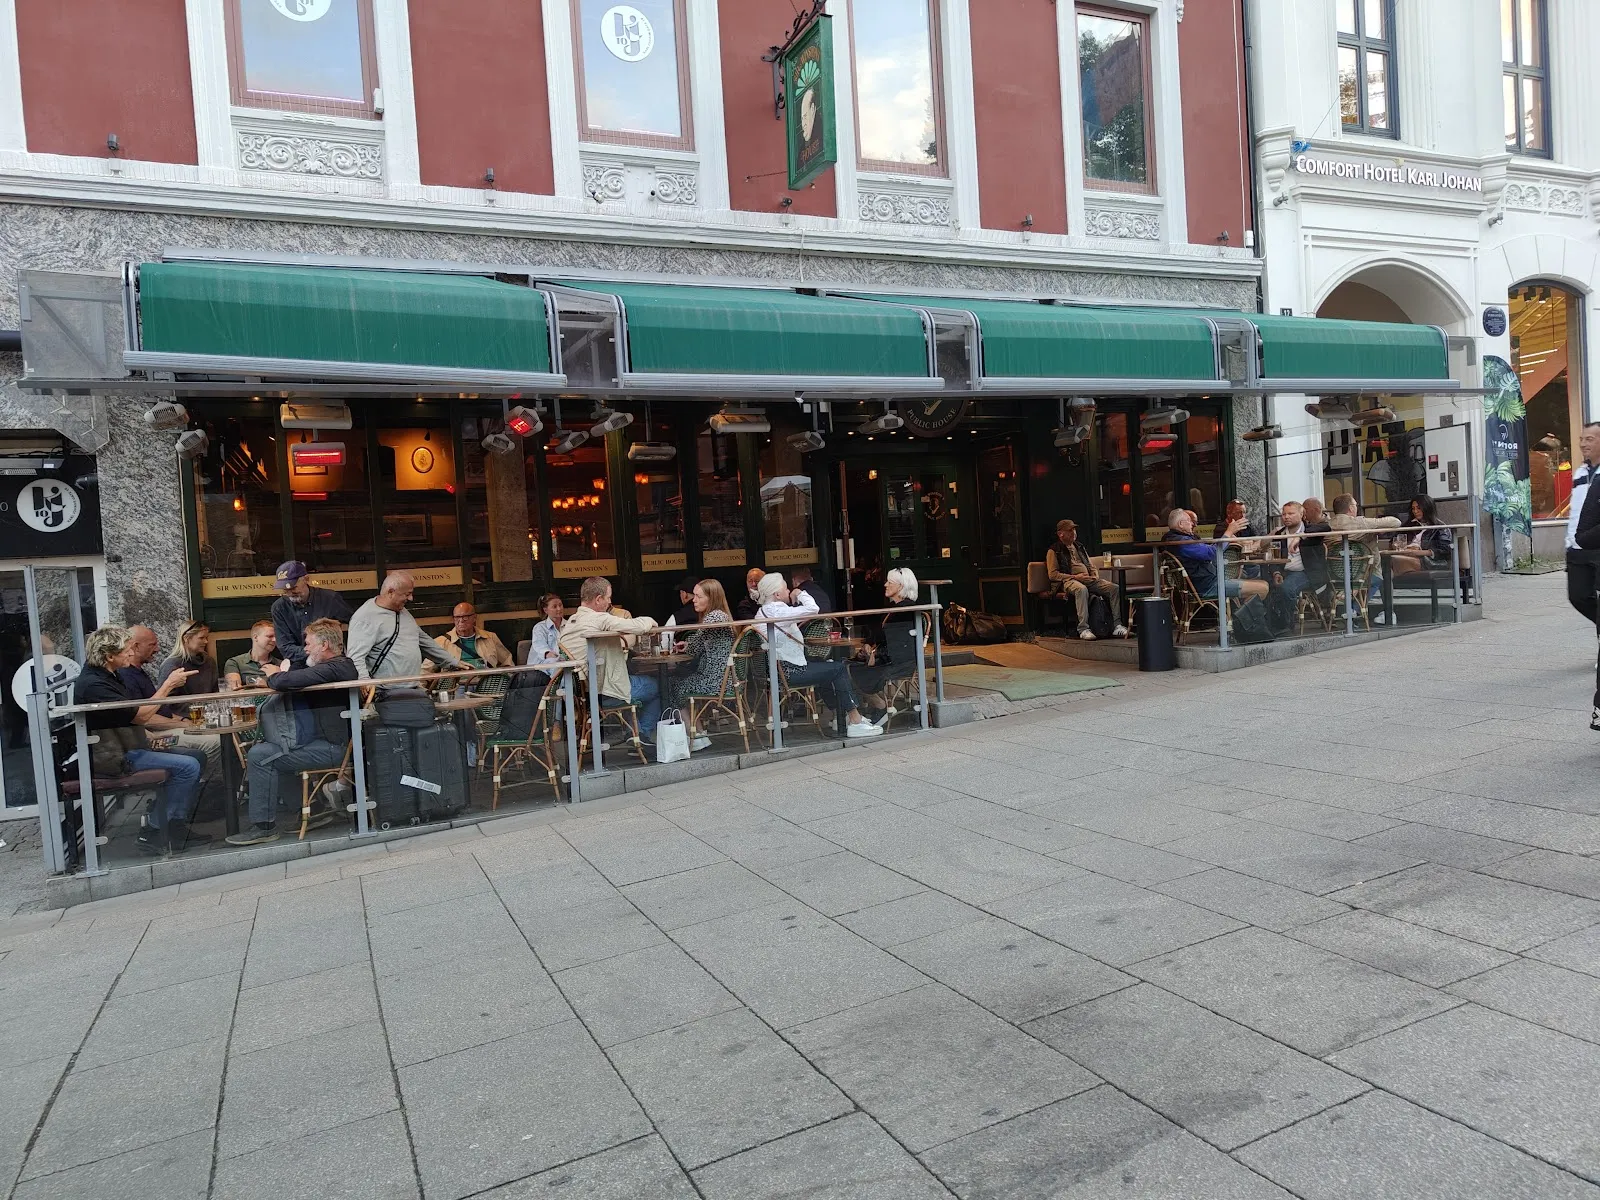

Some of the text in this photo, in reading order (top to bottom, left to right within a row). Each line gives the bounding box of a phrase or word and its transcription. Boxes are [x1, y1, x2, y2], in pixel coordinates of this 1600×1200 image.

[1296, 155, 1482, 192] COMFORT HOTEL KARL JOHAN
[907, 407, 957, 429] PUBLIC HOUSE
[643, 559, 664, 567] PUBLIC
[574, 564, 609, 573] WINSTON'S
[340, 577, 365, 585] HOUSE
[413, 573, 451, 582] WINSTON'S
[232, 581, 274, 591] WINSTON'S
